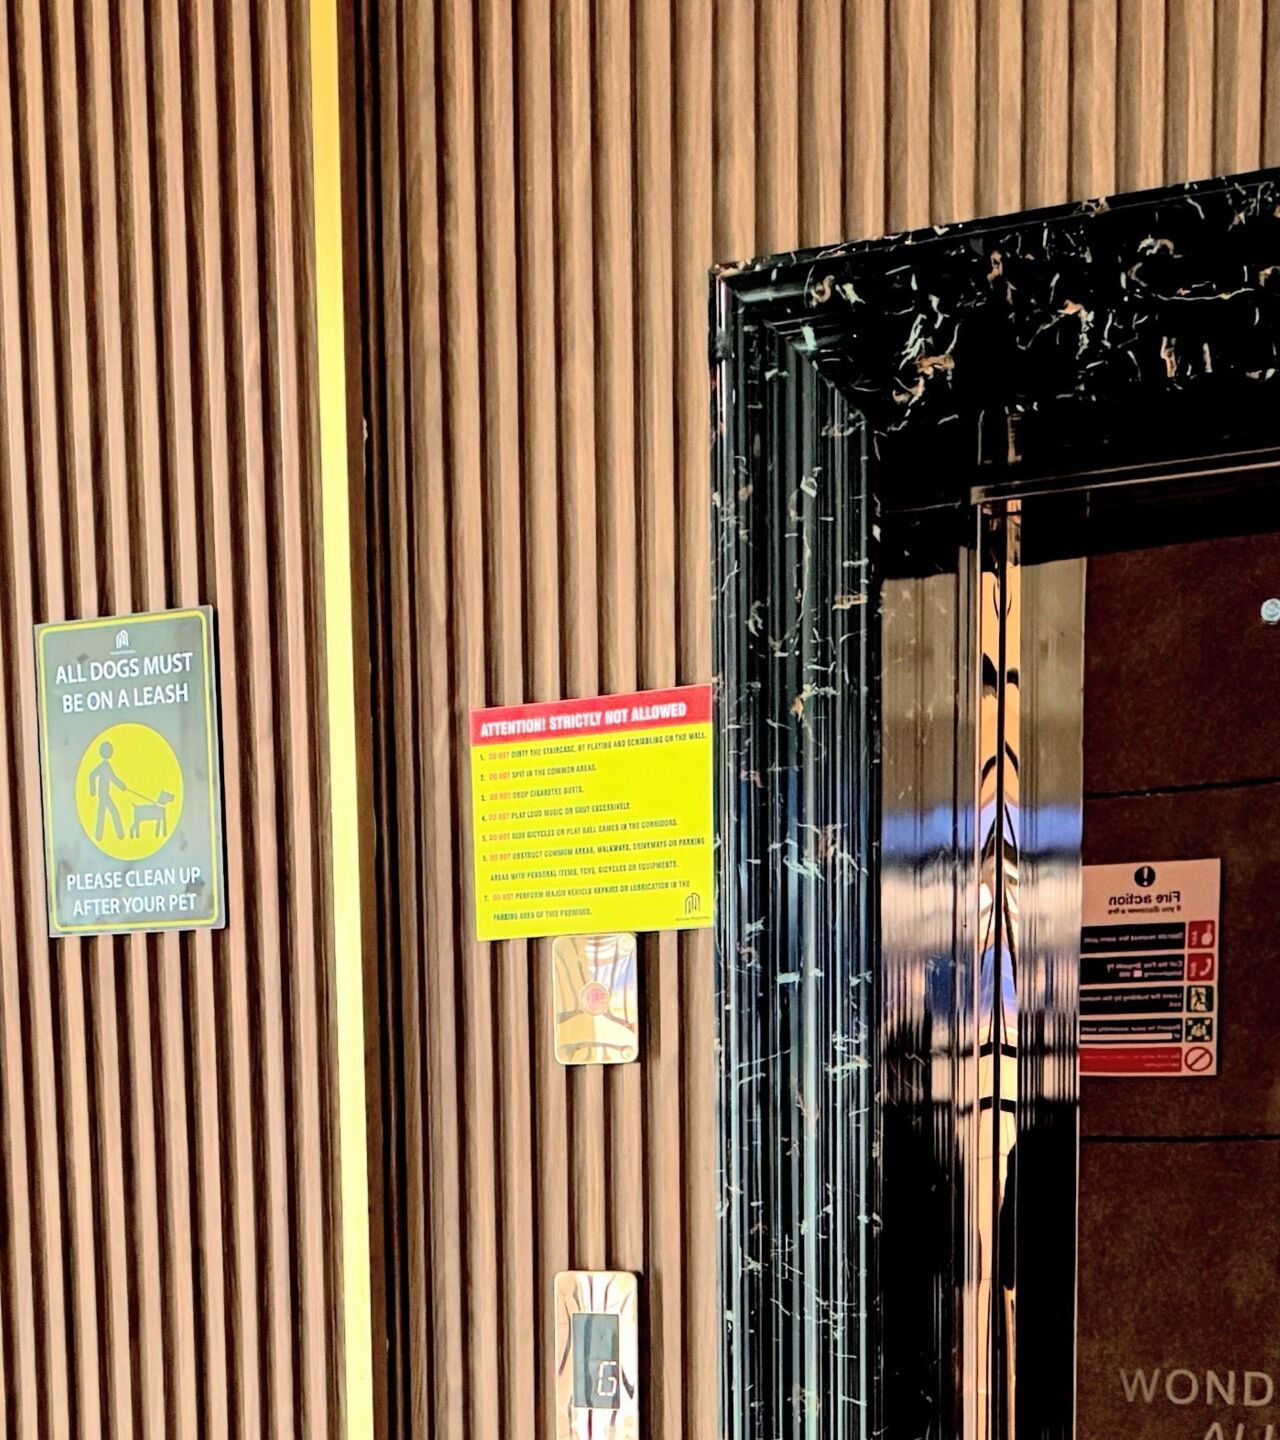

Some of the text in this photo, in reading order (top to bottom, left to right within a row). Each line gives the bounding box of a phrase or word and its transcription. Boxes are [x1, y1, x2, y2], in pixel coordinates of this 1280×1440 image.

[55, 652, 193, 685] ALL DOGS MUST
[62, 683, 189, 714] BE ON A LEASH
[480, 702, 687, 737] ATTENTION! STRICTLY NOT ALLOWED
[66, 866, 201, 891] PLEASE CLEAN UP
[72, 893, 197, 917] AFTER YOUR PET
